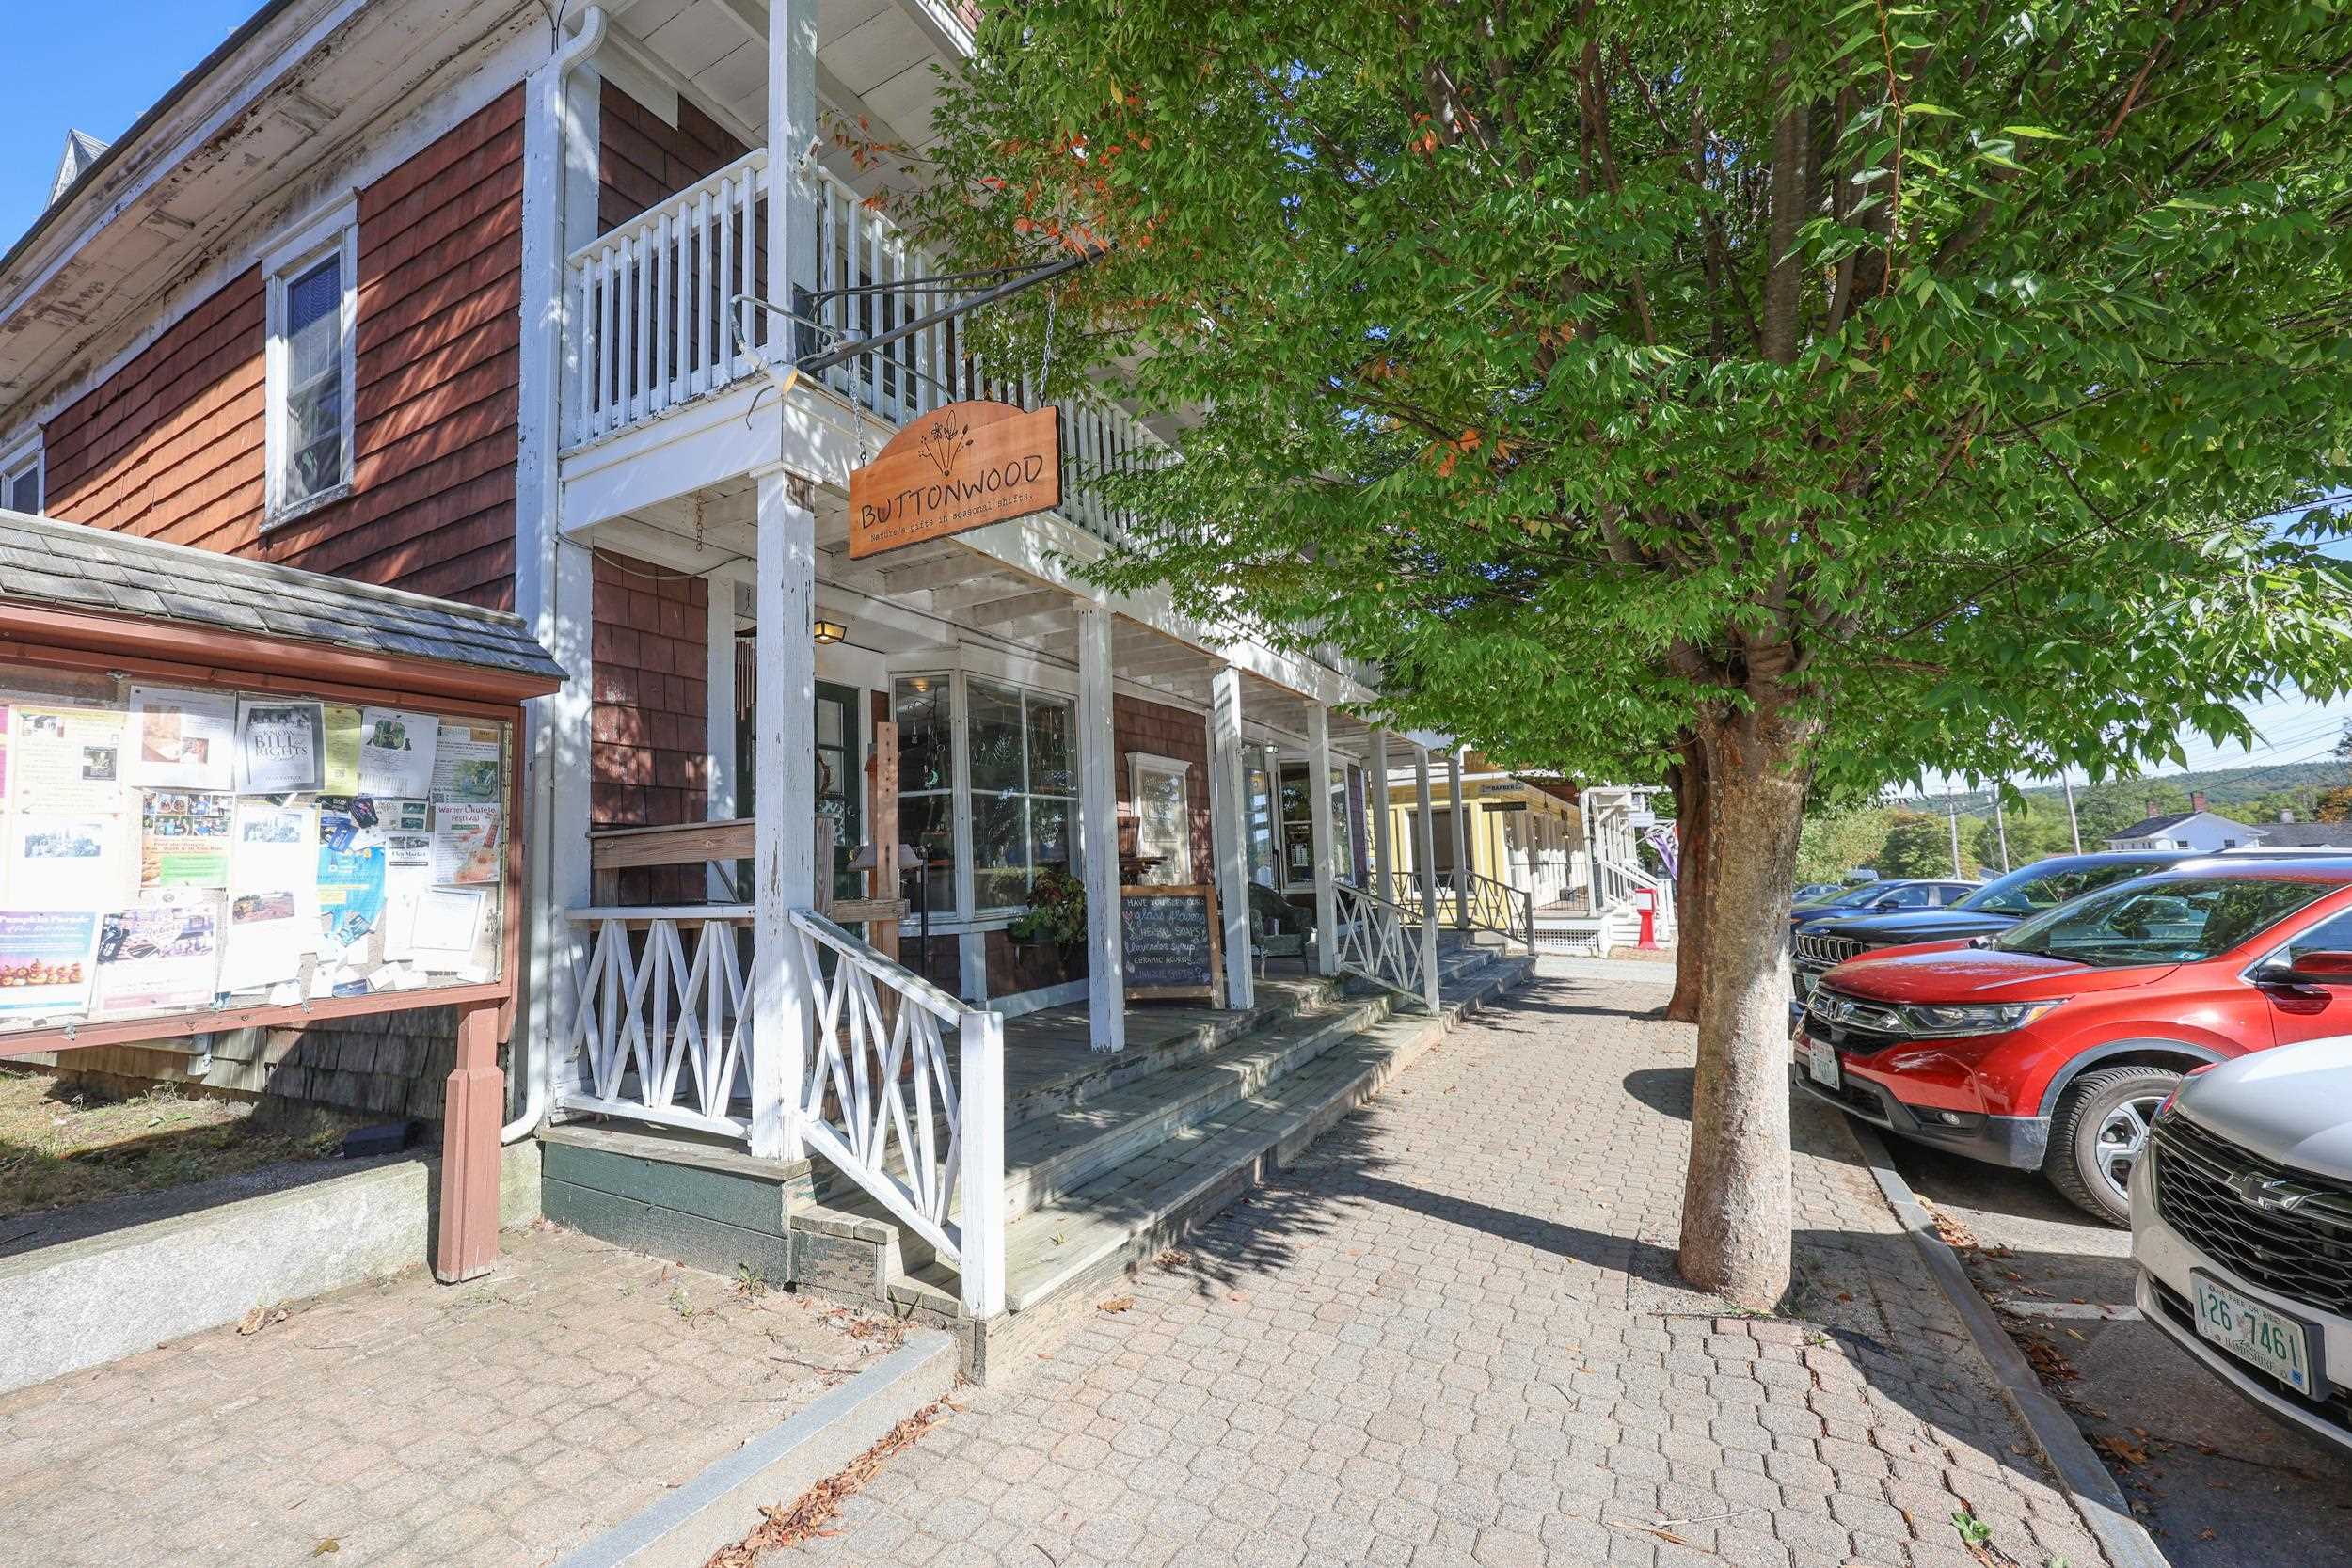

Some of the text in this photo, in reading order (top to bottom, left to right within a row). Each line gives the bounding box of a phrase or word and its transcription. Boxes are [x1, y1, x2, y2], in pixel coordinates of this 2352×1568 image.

[861, 454, 1044, 530] BUTTONWOOD
[870, 525, 906, 543] Nature's
[909, 518, 934, 533] gifts
[938, 514, 949, 524] in
[952, 502, 993, 519] seasonal
[1128, 898, 1148, 908] HAVE
[2198, 1286, 2298, 1369] 126 7461
